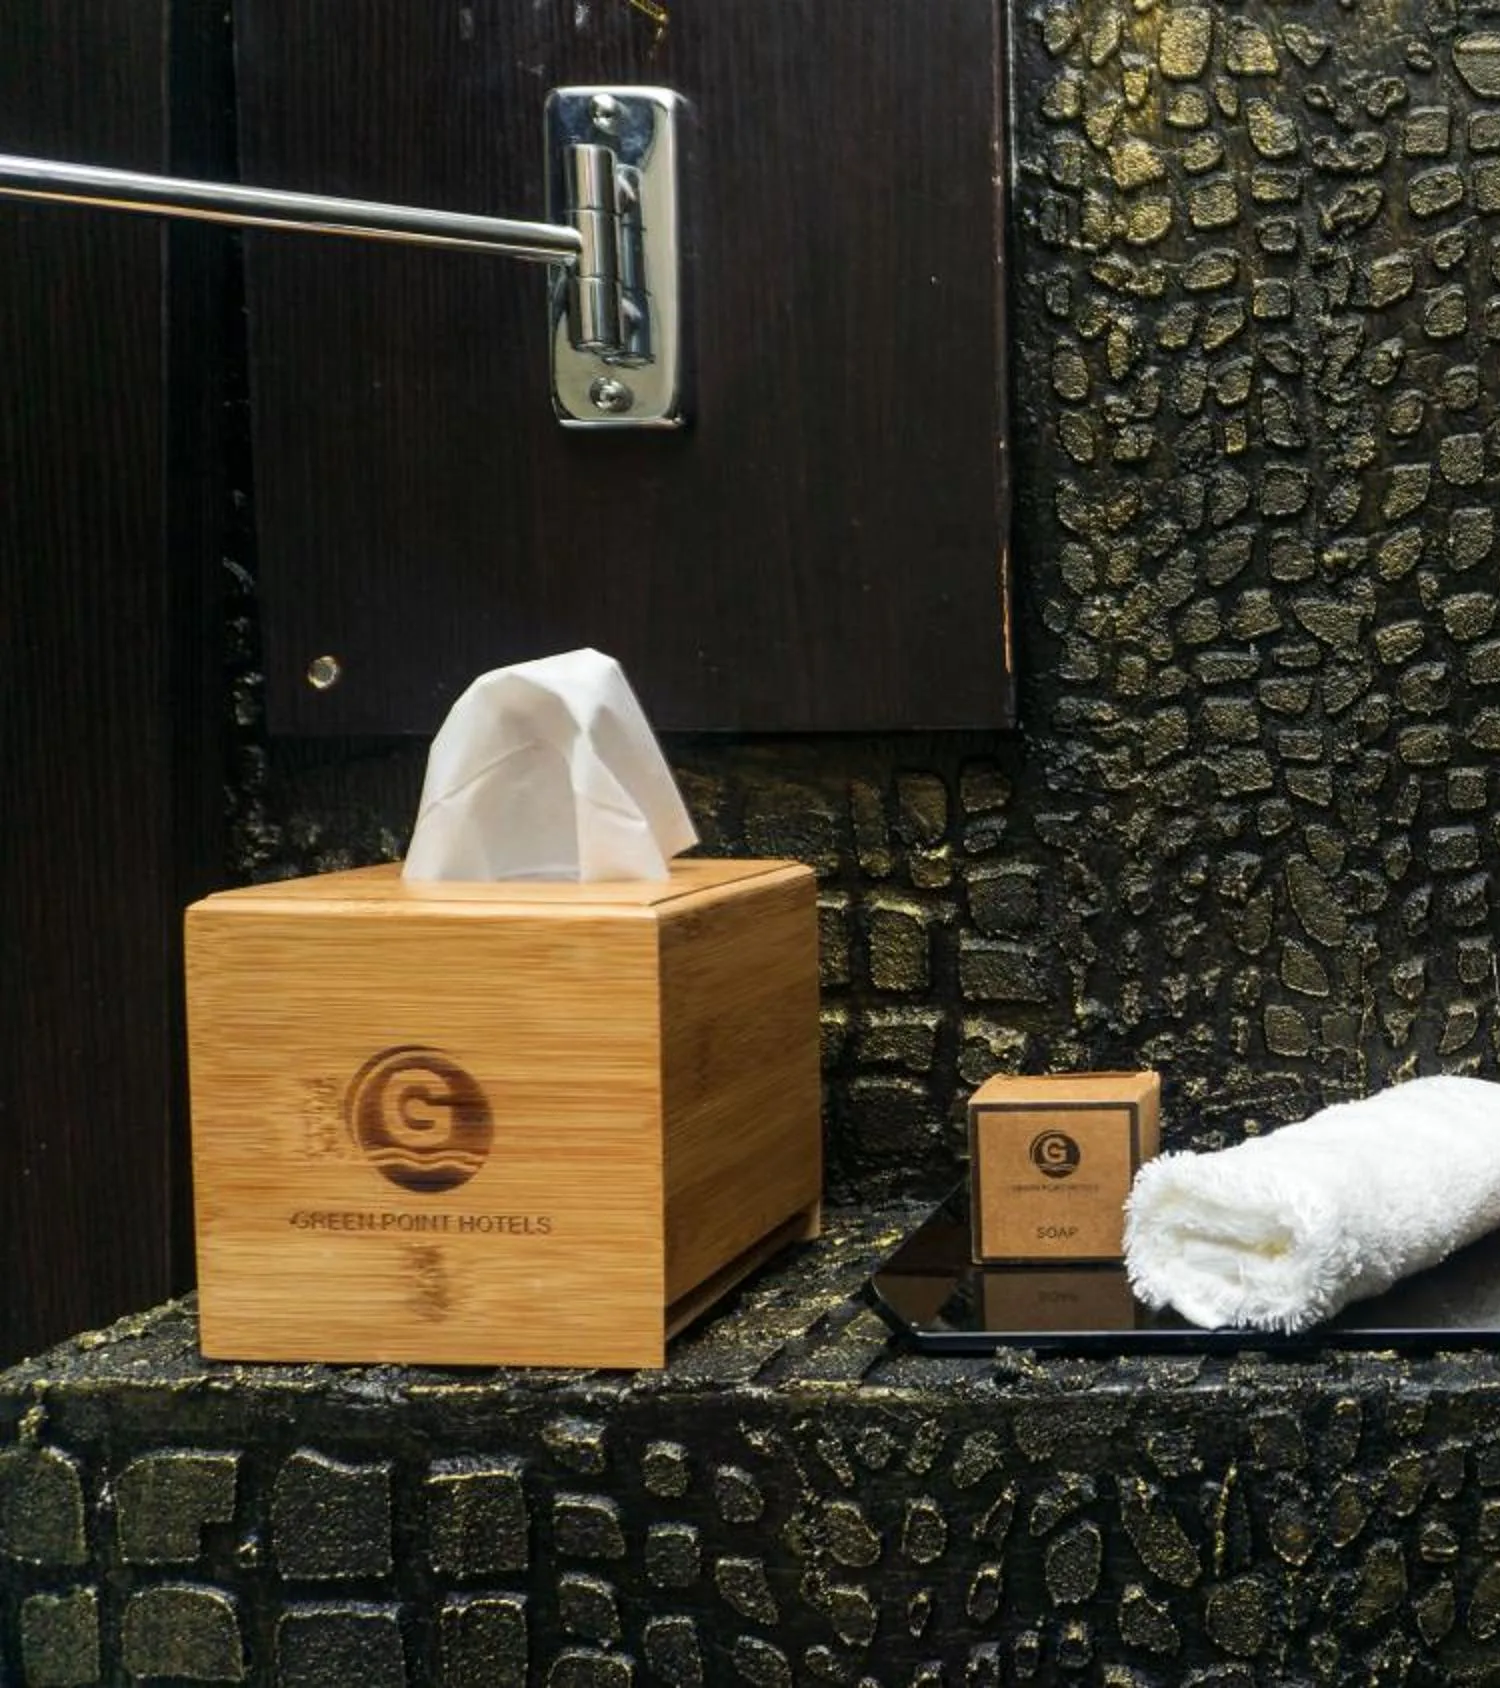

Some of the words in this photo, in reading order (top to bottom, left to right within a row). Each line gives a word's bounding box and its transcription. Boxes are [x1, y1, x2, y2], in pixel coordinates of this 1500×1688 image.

[382, 1067, 451, 1148] G
[291, 1210, 375, 1231] GREEN
[381, 1213, 450, 1233] POINT
[458, 1215, 552, 1235] HOTELS
[1036, 1226, 1078, 1239] SOAP
